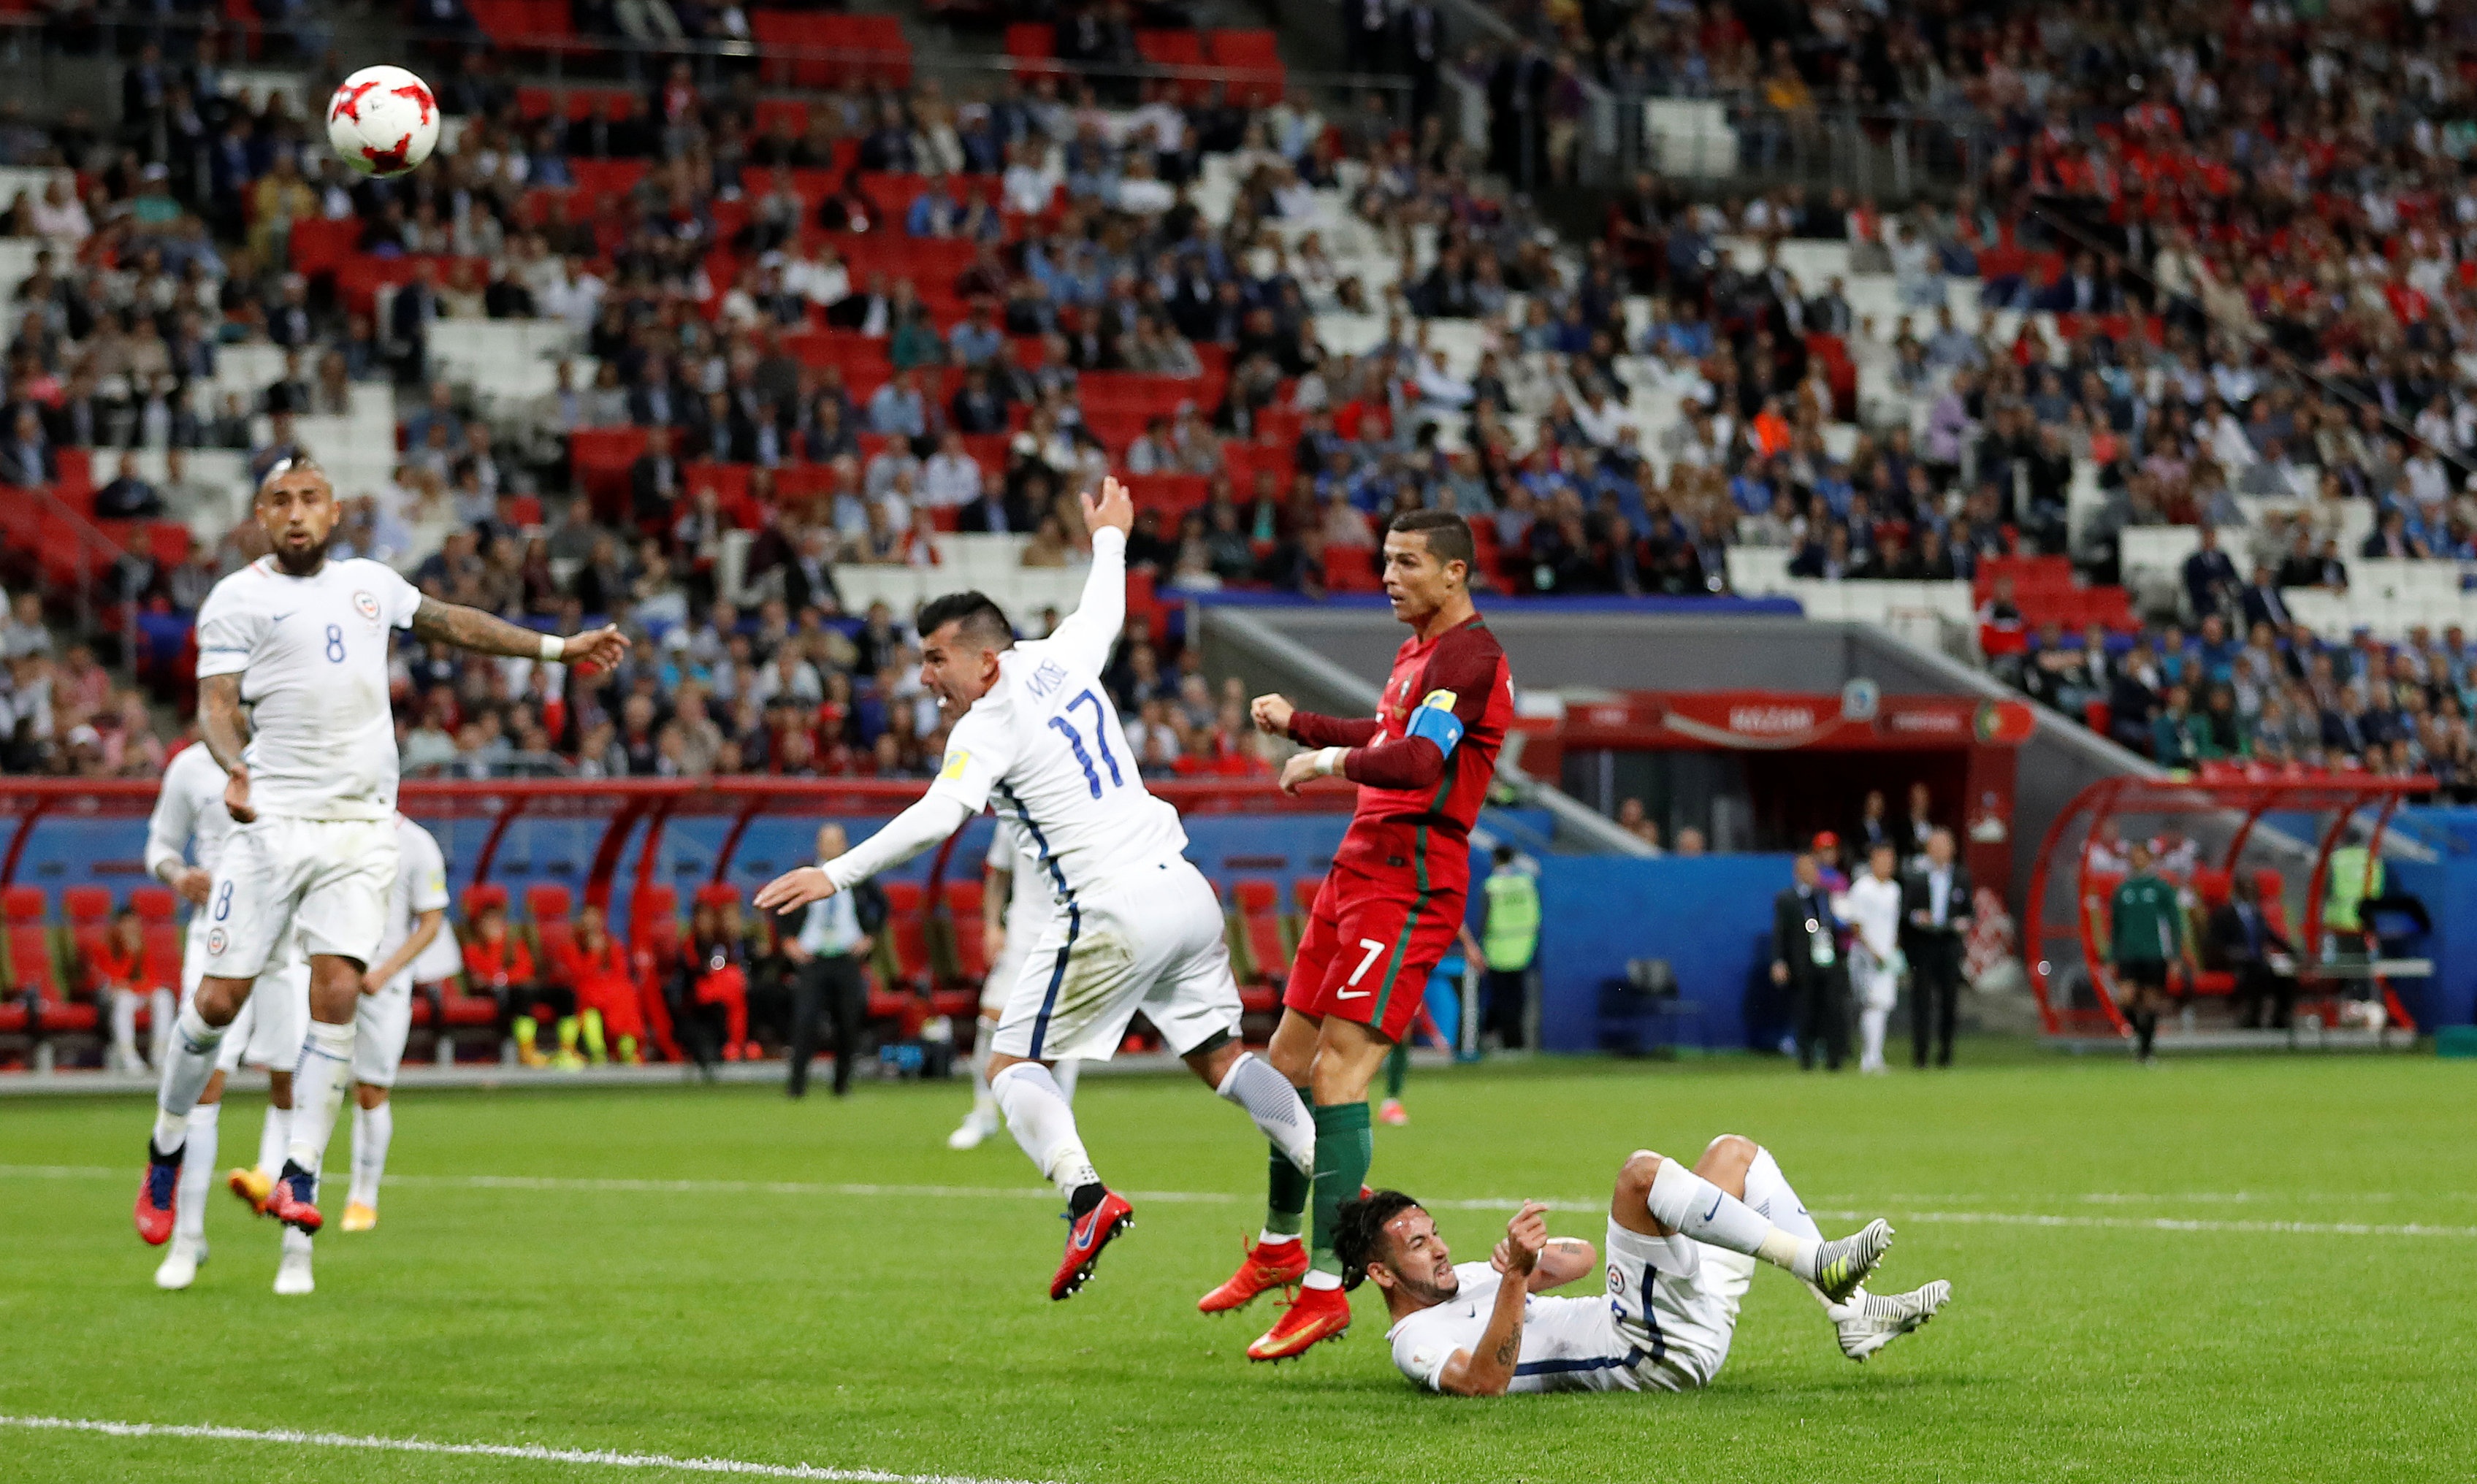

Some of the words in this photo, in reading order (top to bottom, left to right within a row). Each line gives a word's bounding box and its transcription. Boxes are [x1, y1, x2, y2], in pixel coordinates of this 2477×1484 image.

[326, 624, 346, 663] 8
[1048, 689, 1124, 799] 17
[215, 880, 234, 922] 8
[1348, 938, 1386, 987] 7
